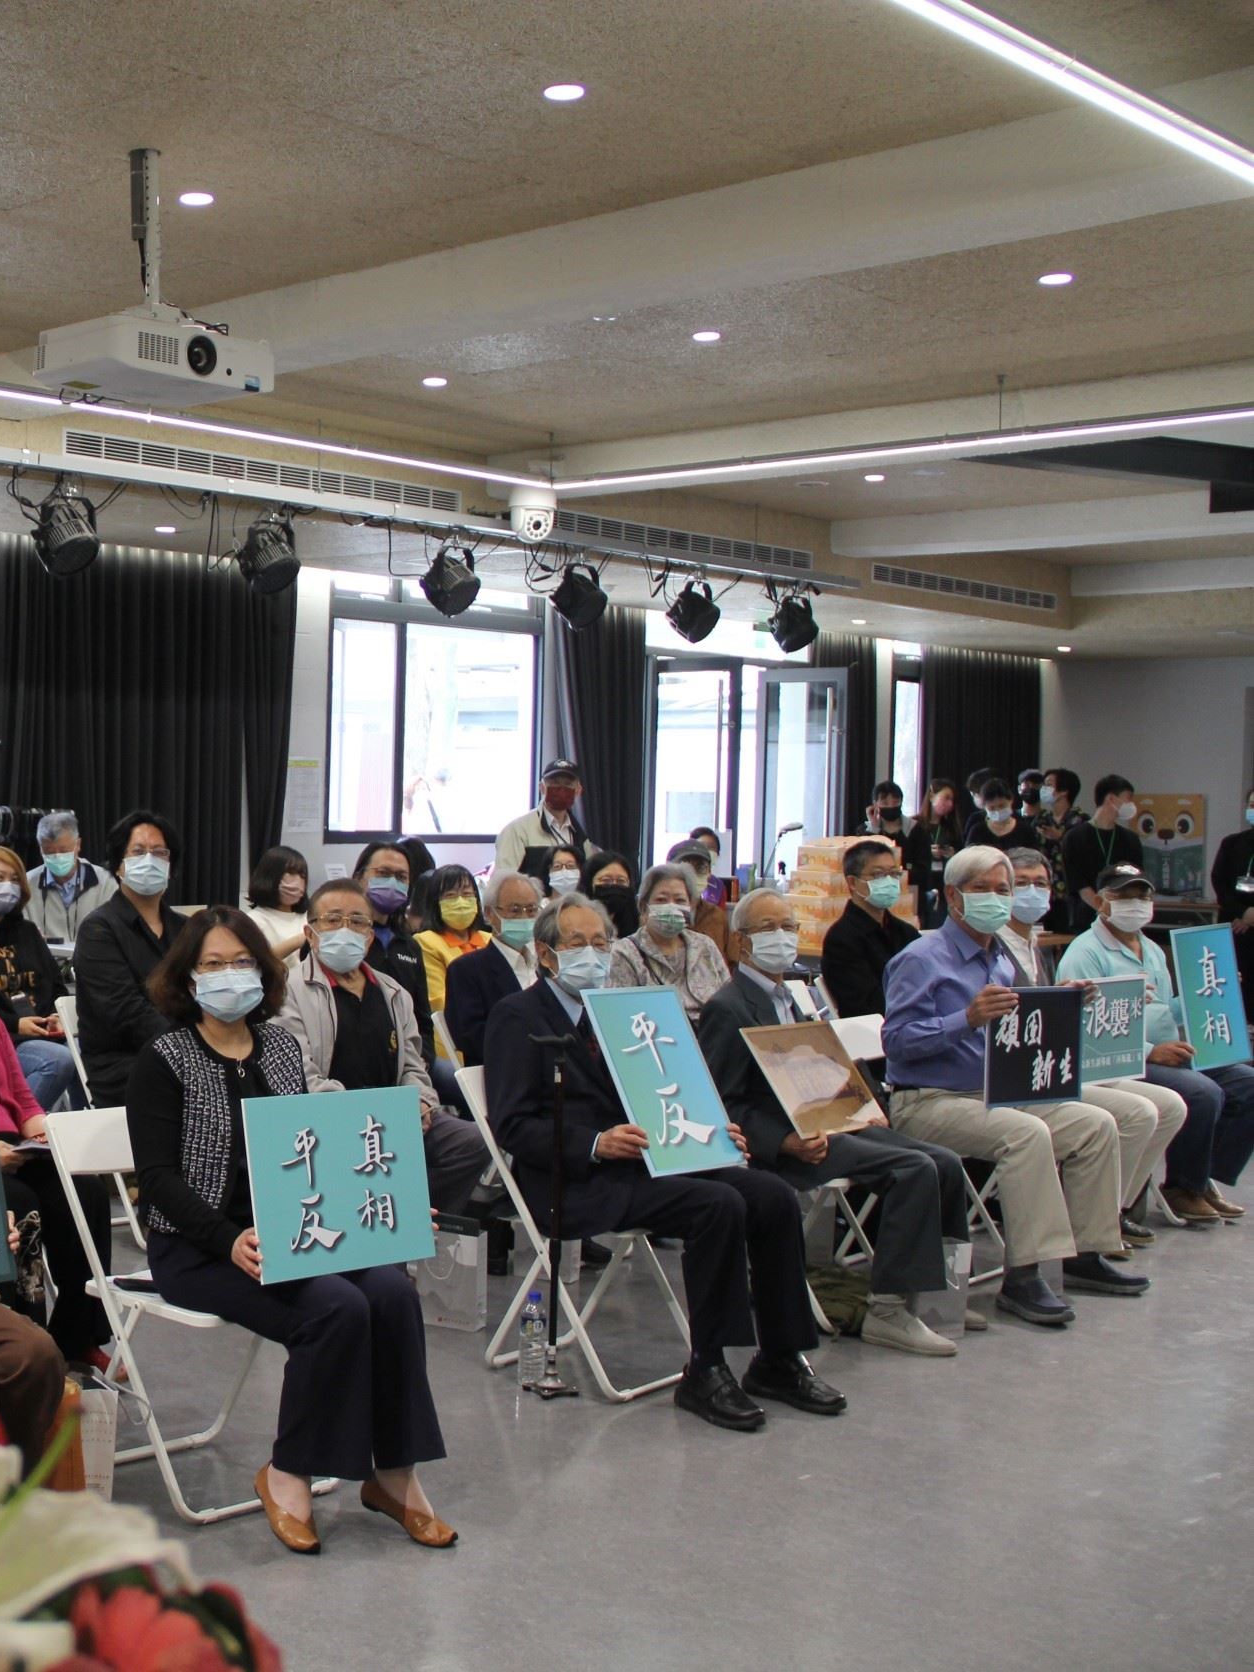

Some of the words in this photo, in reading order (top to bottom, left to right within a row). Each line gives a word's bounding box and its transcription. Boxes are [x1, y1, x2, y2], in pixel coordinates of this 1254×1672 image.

[995, 1005, 1042, 1052] 頑固
[1082, 990, 1142, 1039] 浪襲來
[1196, 946, 1230, 1045] 真相
[622, 1012, 715, 1145] 平反
[1032, 1047, 1073, 1091] 新生
[281, 1128, 344, 1250] 平反
[353, 1115, 394, 1230] 真相
